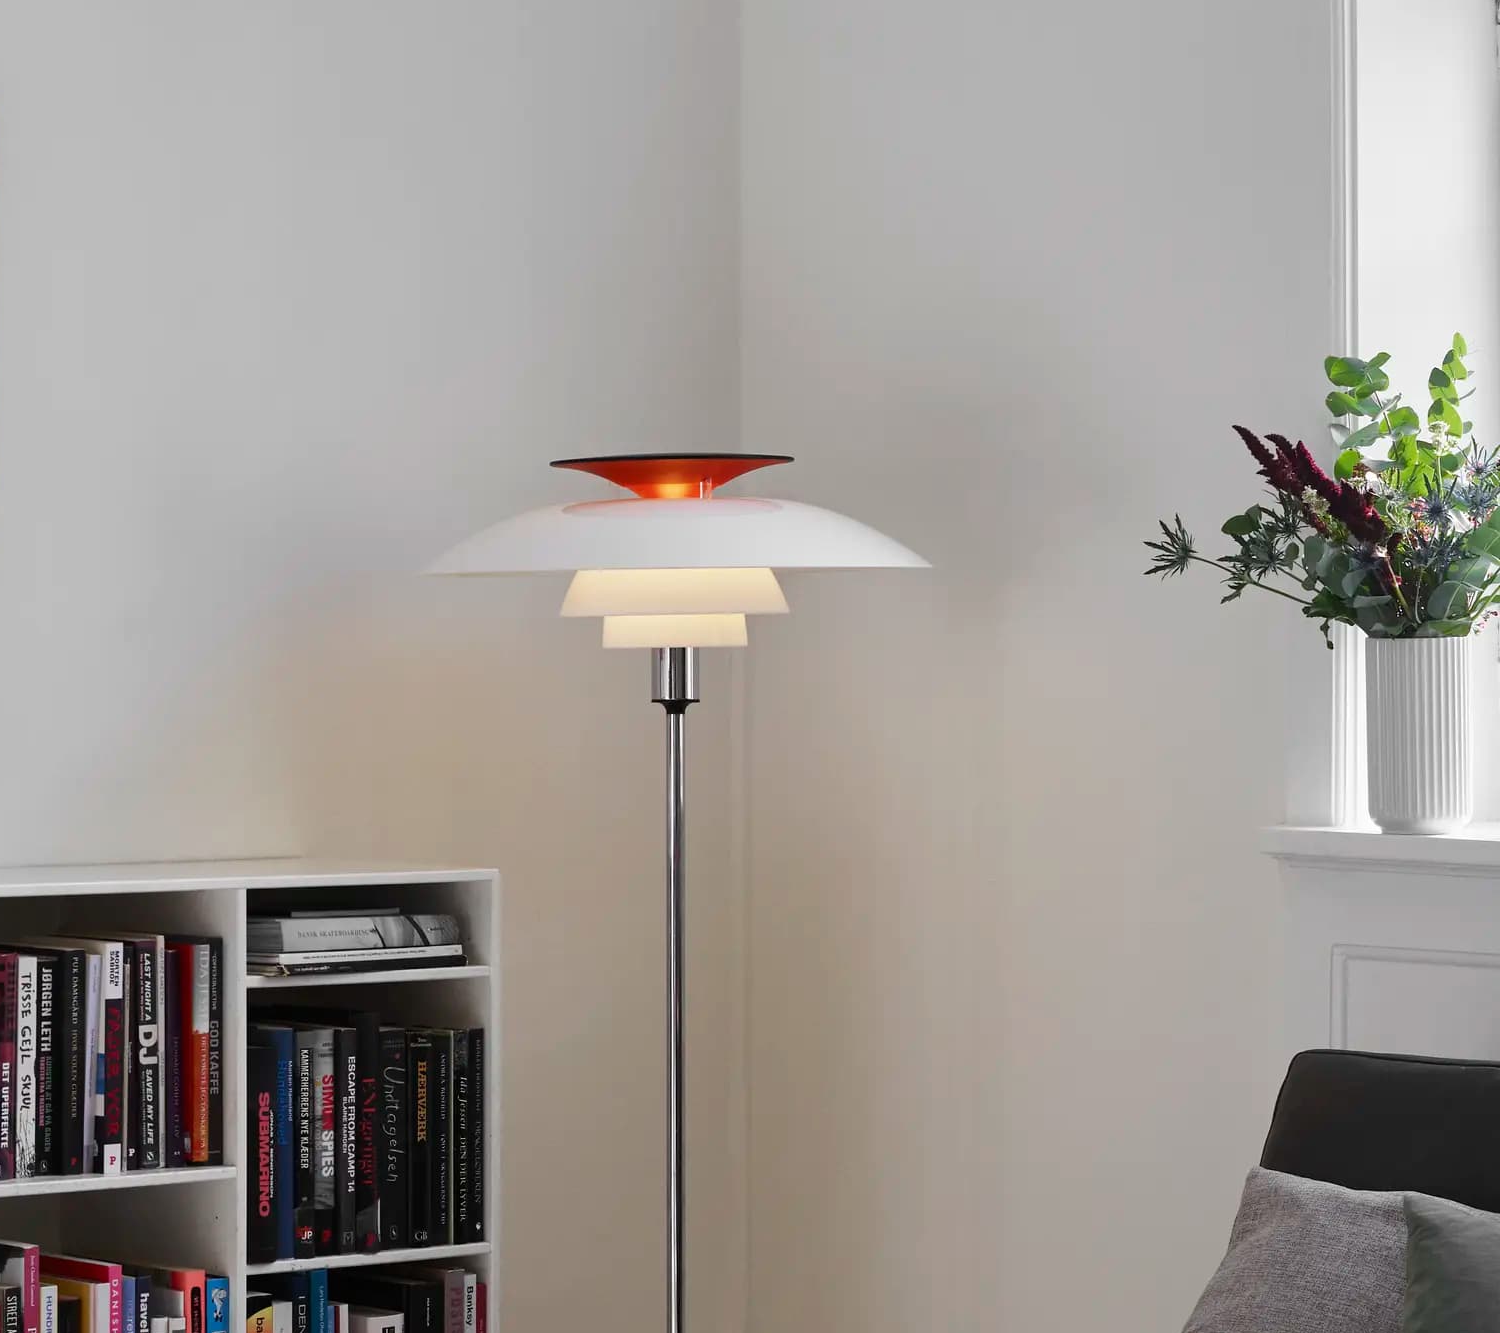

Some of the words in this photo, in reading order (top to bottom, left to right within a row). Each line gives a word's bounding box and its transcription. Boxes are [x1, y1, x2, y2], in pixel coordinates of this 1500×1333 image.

[41, 967, 52, 1016] JØRGEN
[145, 1010, 151, 1021] A
[41, 1021, 51, 1051] LETH
[139, 1025, 157, 1064] DJ
[210, 1021, 219, 1046] GOD
[1, 1062, 10, 1083] DET
[210, 1051, 219, 1094] KAFFE
[301, 1050, 309, 1117] KAMMERHERRENS
[1, 1087, 9, 1148] UPERFEKTE
[147, 1104, 153, 1119] MY
[301, 1119, 309, 1134] NYE
[259, 1092, 269, 1216] SUBMARINO
[300, 1137, 309, 1169] KLÆDER
[348, 1181, 354, 1192] 14
[7, 1296, 17, 1326] STREET
